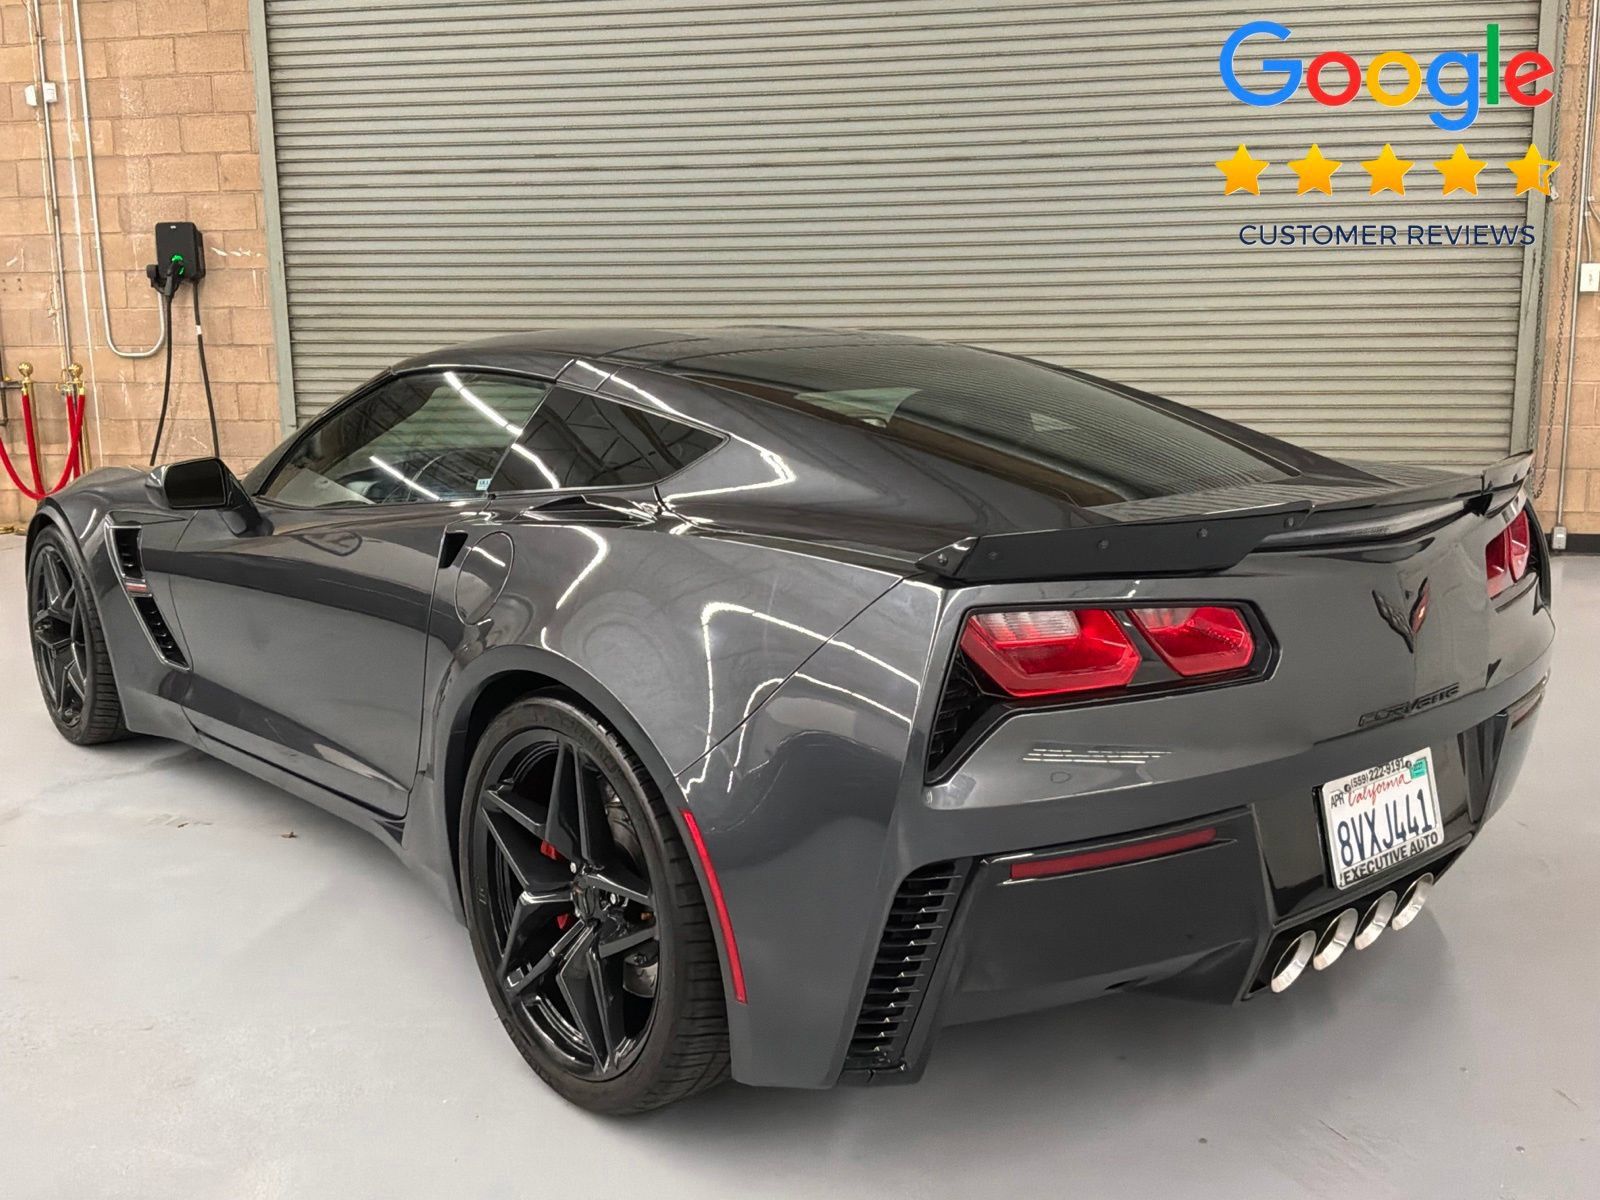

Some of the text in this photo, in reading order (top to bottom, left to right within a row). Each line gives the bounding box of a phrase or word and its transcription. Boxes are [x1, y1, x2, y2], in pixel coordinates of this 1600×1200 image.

[1369, 757, 1406, 781] 222-9191
[1330, 791, 1345, 809] APR
[1347, 773, 1412, 807] California
[1337, 788, 1433, 868] 8VXJ441
[1343, 831, 1439, 885] EXECUTIVE AUTO
